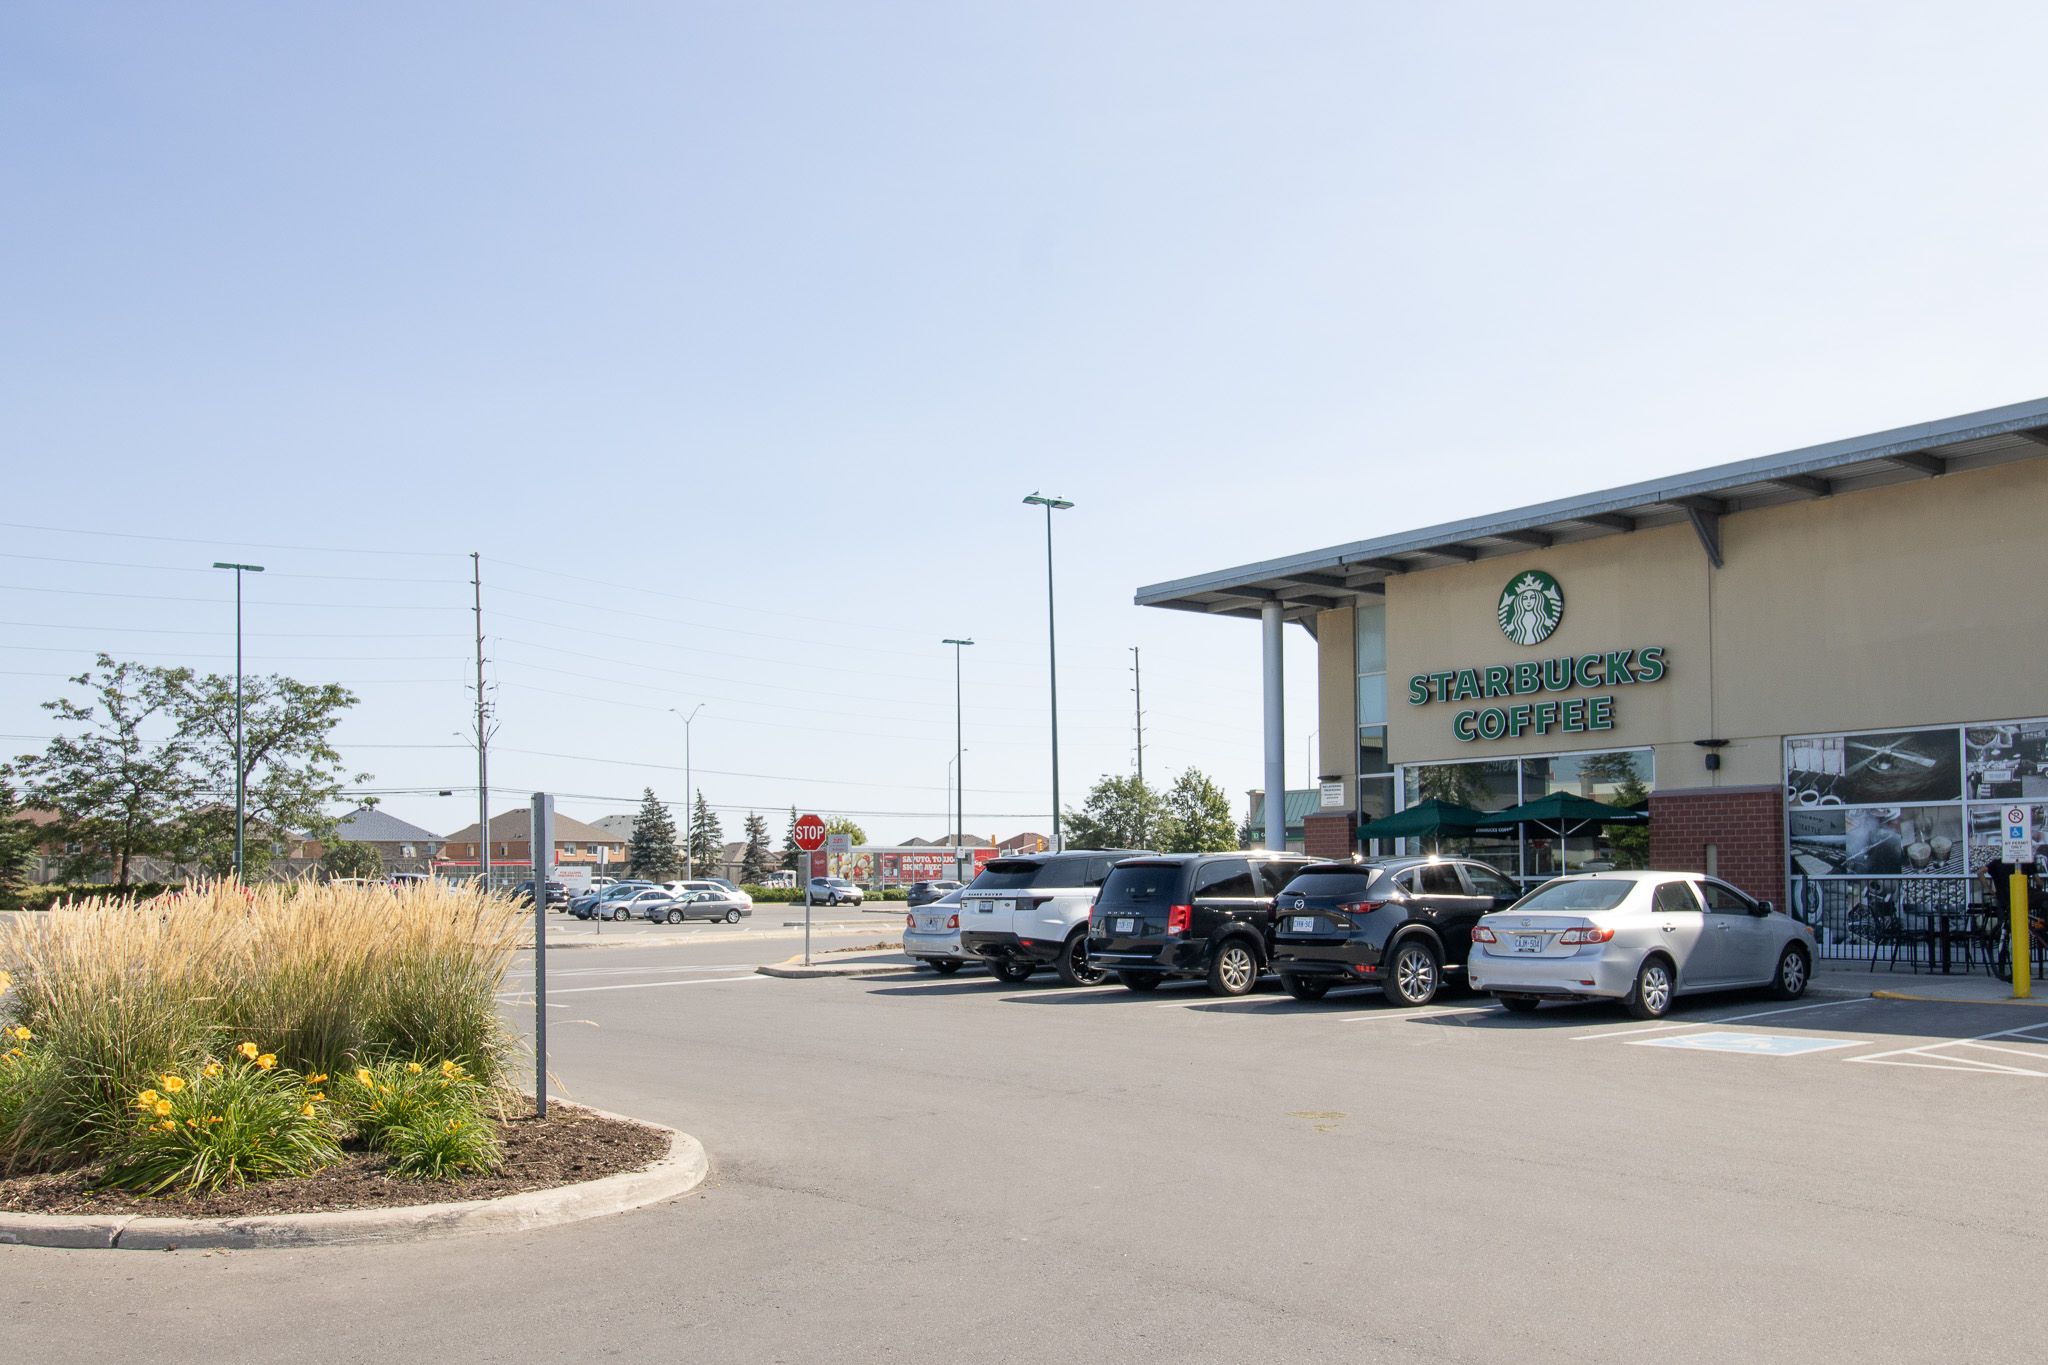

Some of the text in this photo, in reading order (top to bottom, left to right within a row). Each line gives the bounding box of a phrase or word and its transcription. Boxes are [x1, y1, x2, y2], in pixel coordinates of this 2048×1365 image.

[1407, 647, 1665, 706] STARBUCKS
[1452, 695, 1614, 742] COFFEE
[795, 825, 824, 840] STOP
